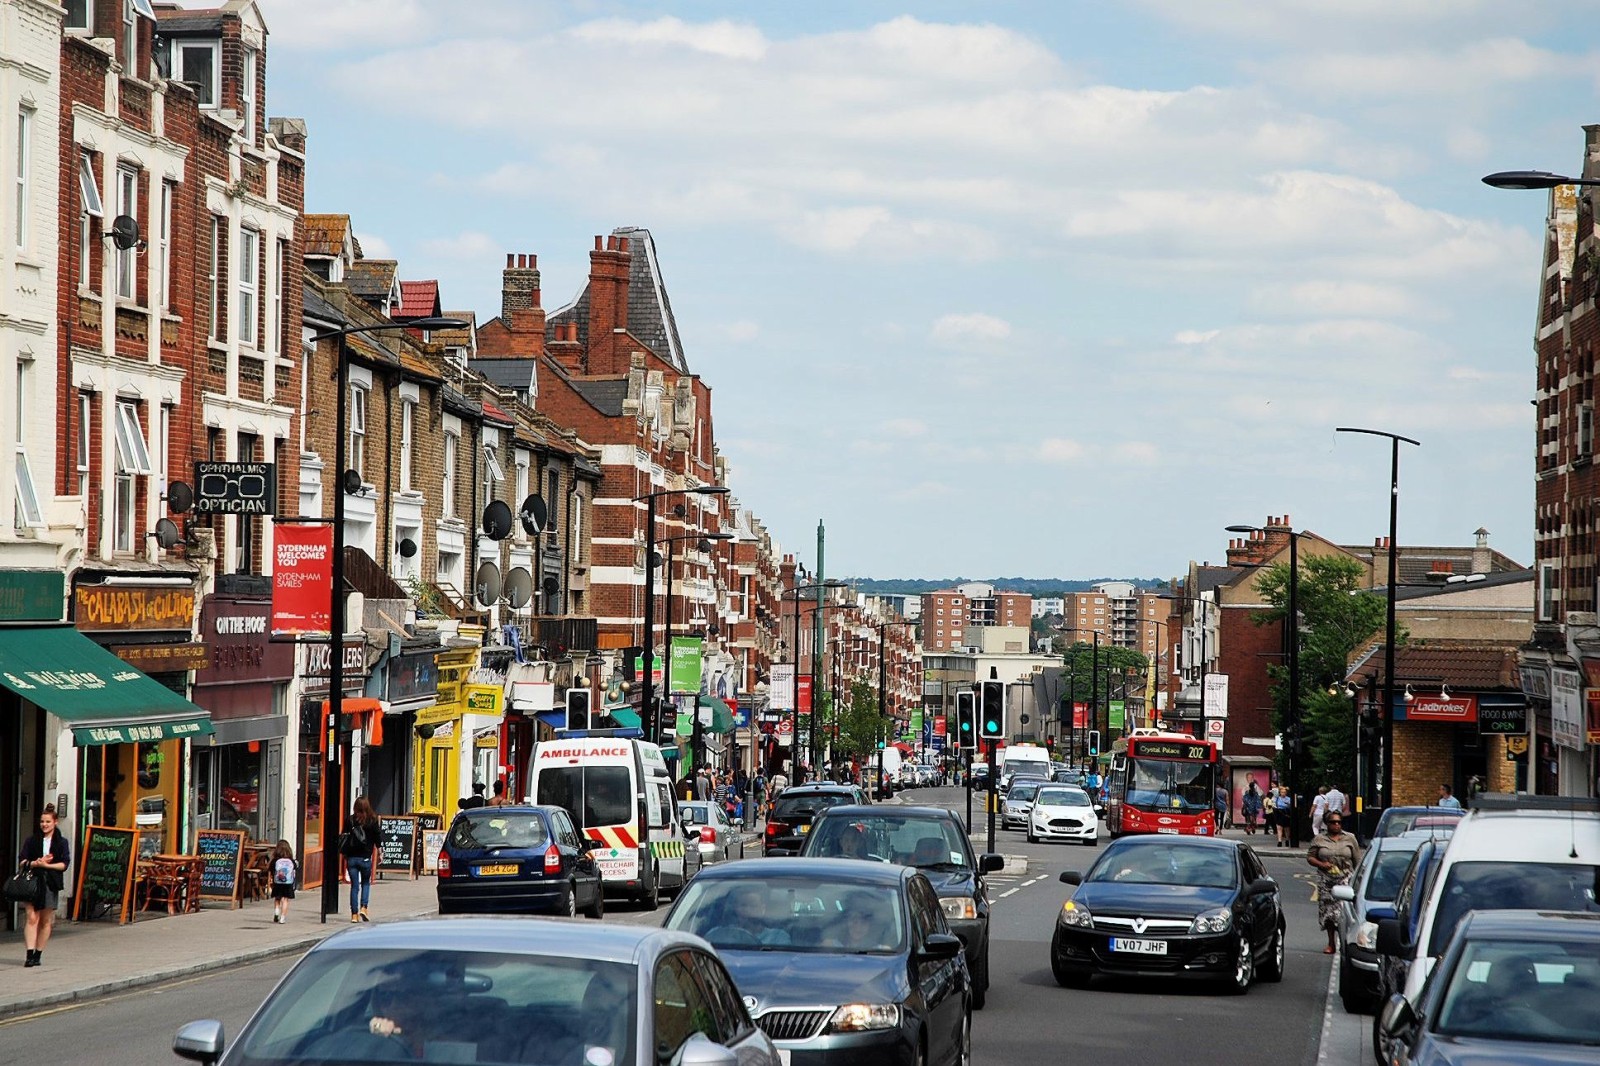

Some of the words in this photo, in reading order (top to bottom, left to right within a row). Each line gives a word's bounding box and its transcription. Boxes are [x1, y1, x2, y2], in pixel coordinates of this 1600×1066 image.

[200, 464, 267, 474] OPHTHALMIC
[199, 498, 266, 513] OPTICIAN
[277, 544, 327, 552] SYDENHAM
[277, 551, 325, 560] WELCOMES
[277, 559, 297, 567] YOU
[277, 572, 321, 581] SYDENHAM
[276, 580, 302, 588] SMILES
[76, 588, 88, 604] THE
[88, 591, 146, 624] CALABASH
[154, 592, 194, 622] CULTURE
[216, 616, 229, 634] ON
[229, 616, 245, 634] THE
[245, 616, 266, 634] HOOF
[1417, 702, 1465, 713] Ladbrokes
[1481, 710, 1501, 719] FOOD
[1502, 710, 1507, 719] &
[1508, 711, 1525, 719] WINE
[1491, 722, 1514, 730] OPEN
[541, 748, 628, 758] AMBULANCE
[1140, 745, 1160, 754] Crystal
[1188, 746, 1204, 759] 202
[1115, 938, 1142, 950] LV07
[1145, 940, 1165, 952] JHF
